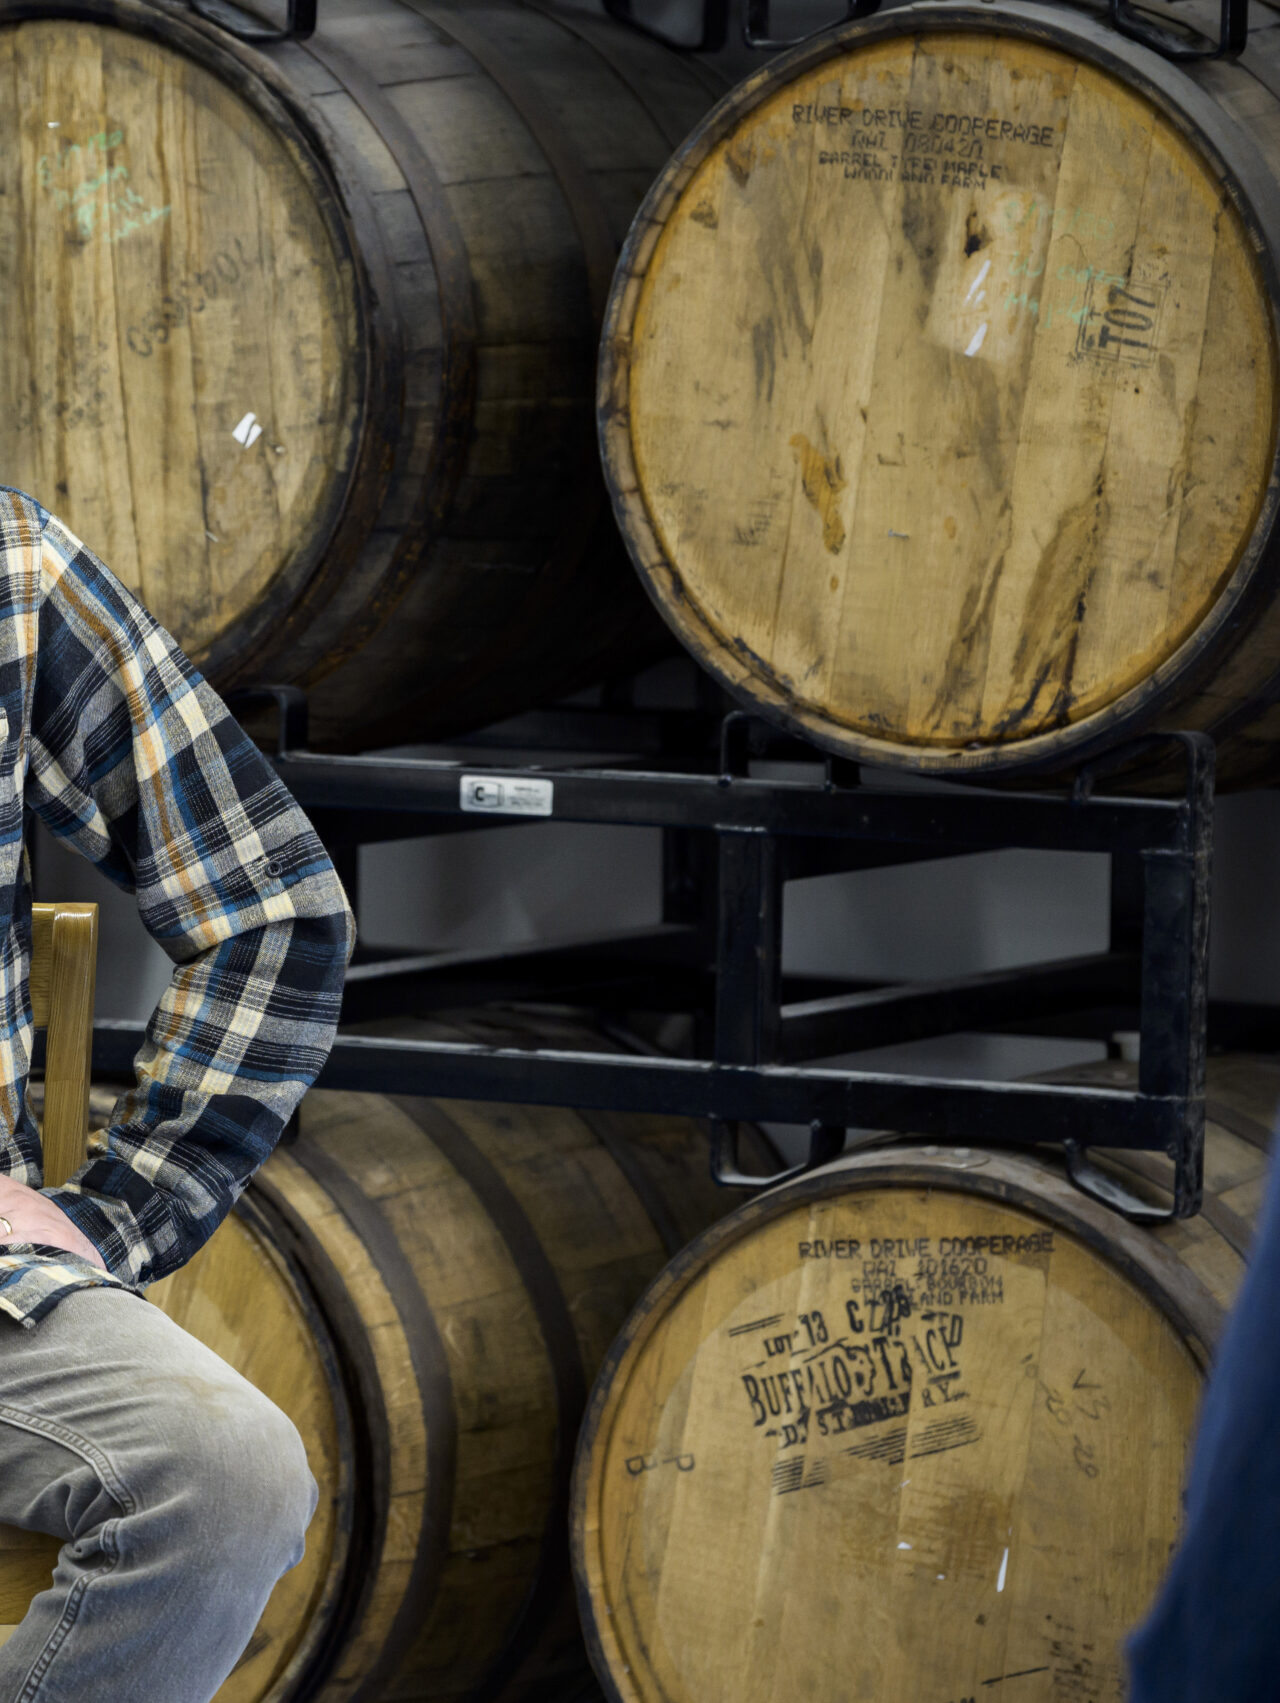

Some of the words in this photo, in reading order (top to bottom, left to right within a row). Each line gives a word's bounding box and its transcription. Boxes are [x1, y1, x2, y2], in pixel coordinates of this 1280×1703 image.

[792, 104, 853, 126] RIVER
[862, 108, 923, 129] DRIVE
[931, 112, 1054, 148] COOPERAGE
[819, 151, 881, 168] BARREL
[944, 160, 1003, 179] MAPLE
[941, 172, 987, 190] FARM
[1098, 284, 1157, 349] T07
[799, 1239, 861, 1260] RIVER
[870, 1237, 931, 1259] DRIVE
[939, 1232, 1055, 1257] COOPERAGE
[960, 1290, 1005, 1305] FARM
[763, 1334, 793, 1357] LOT
[741, 1354, 853, 1427] BUFFALO
